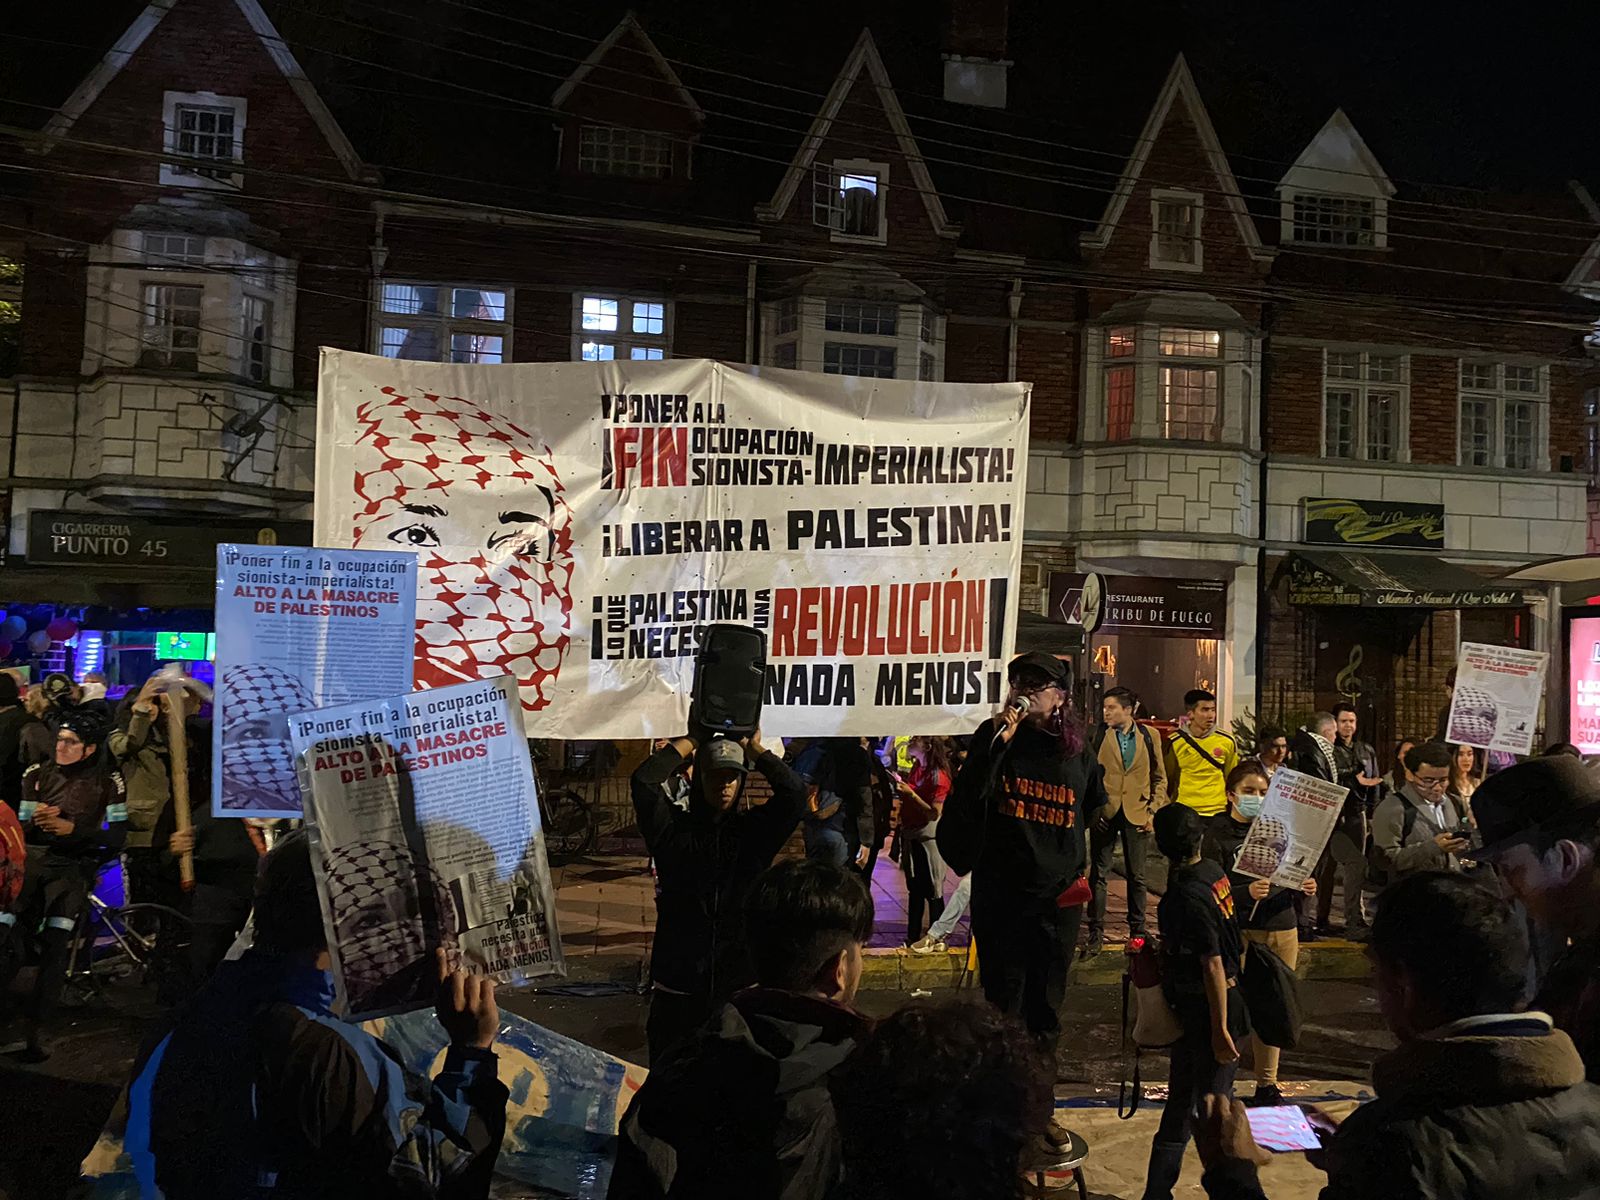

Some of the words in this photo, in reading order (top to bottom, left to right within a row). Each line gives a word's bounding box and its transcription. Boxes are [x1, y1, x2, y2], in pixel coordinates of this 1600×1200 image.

[692, 402, 704, 423] A
[707, 403, 726, 424] LA
[692, 427, 813, 456] OCUPACIÓN
[613, 427, 688, 490] FIN
[787, 503, 1011, 550] PALESTINA!
[51, 535, 129, 556] PUNTO
[139, 540, 168, 557] 45
[225, 552, 274, 568] ¡Poner
[281, 555, 300, 569] fin
[305, 559, 313, 570] a
[319, 558, 332, 571] la
[337, 560, 407, 575] ocupación
[237, 572, 395, 590] sionista-imperialista!
[233, 585, 277, 599] ALTO
[281, 588, 293, 599] A
[297, 588, 317, 601] LA
[322, 590, 400, 604] MASACRE
[629, 589, 747, 625] PALESTINA
[1105, 594, 1165, 605] RESTAURANTE
[254, 601, 275, 614] DE
[280, 603, 380, 618] PALESTINOS
[607, 595, 628, 633] QUE
[754, 589, 770, 629] UNA
[1104, 608, 1143, 622] TRIBU
[1150, 610, 1165, 622] DE
[1171, 610, 1213, 625] FUEGO
[764, 664, 856, 706] NADA
[298, 717, 353, 738] ¡Poner
[361, 710, 384, 727] fin
[390, 710, 400, 721] a
[405, 703, 421, 719] la
[428, 687, 507, 715] ocupación
[315, 706, 499, 754] sionista-imperialista!
[314, 750, 364, 772] ALTO
[368, 748, 383, 762] A
[389, 743, 413, 758] LA
[416, 722, 507, 753] MASACRE
[341, 767, 367, 784] DE
[496, 912, 544, 931] Palestina
[481, 929, 526, 948] necesita
[481, 958, 511, 975] NADA
[513, 947, 553, 969] MENOS!
